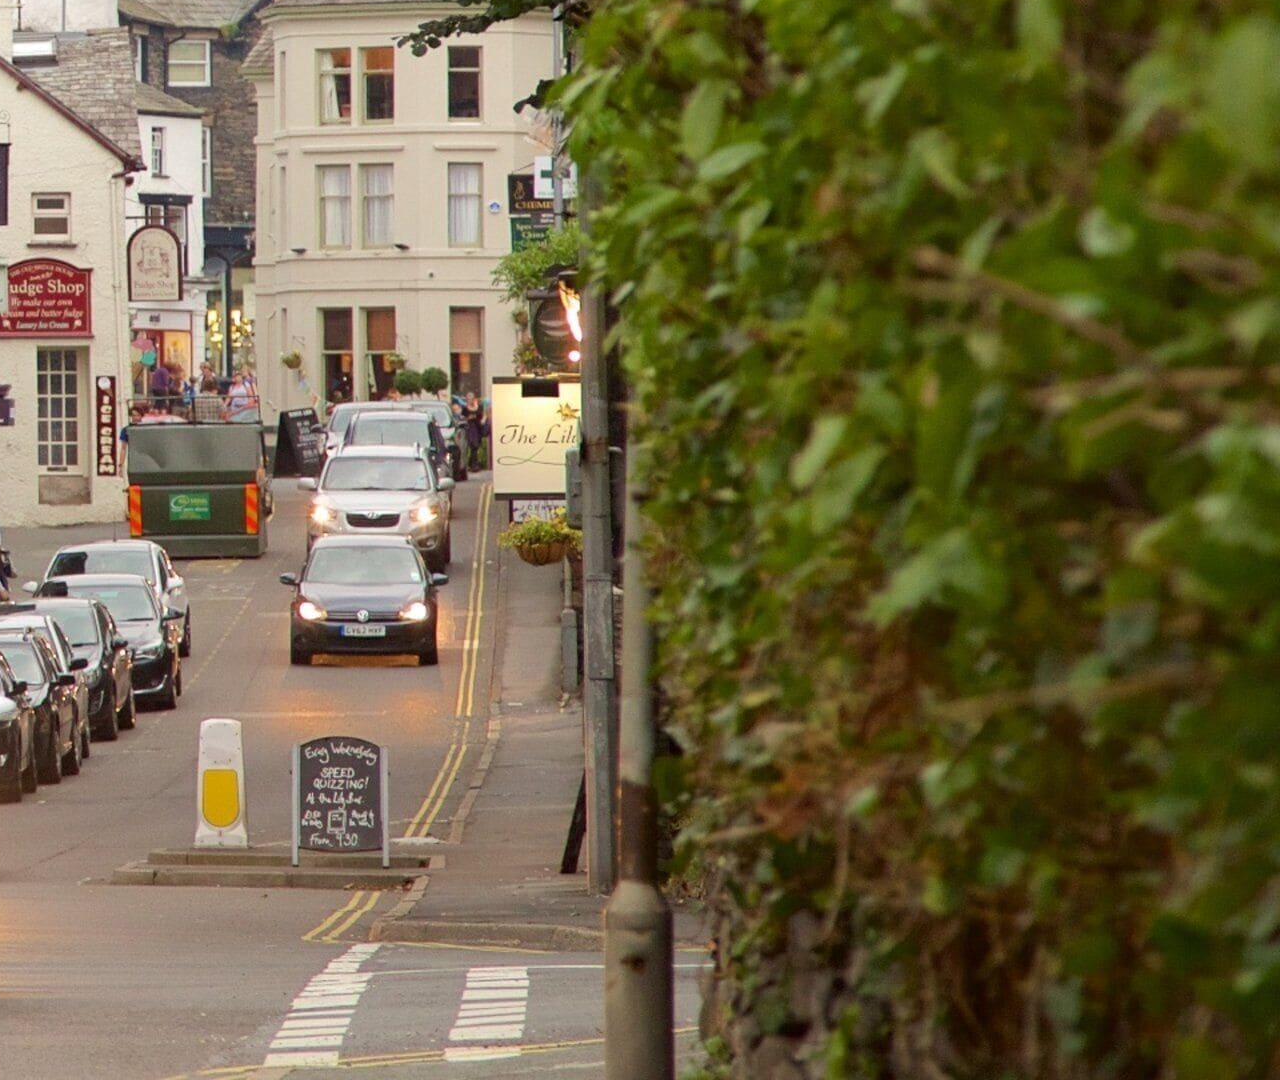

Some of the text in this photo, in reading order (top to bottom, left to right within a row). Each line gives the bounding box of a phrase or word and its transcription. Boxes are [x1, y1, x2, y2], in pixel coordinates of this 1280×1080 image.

[9, 280, 85, 297] udge Shop
[23, 298, 41, 307] make
[26, 309, 40, 318] and
[41, 309, 62, 318] butter
[63, 308, 85, 320] fudge
[500, 424, 537, 445] The
[99, 426, 115, 474] CREAM
[320, 767, 355, 778] SPEED
